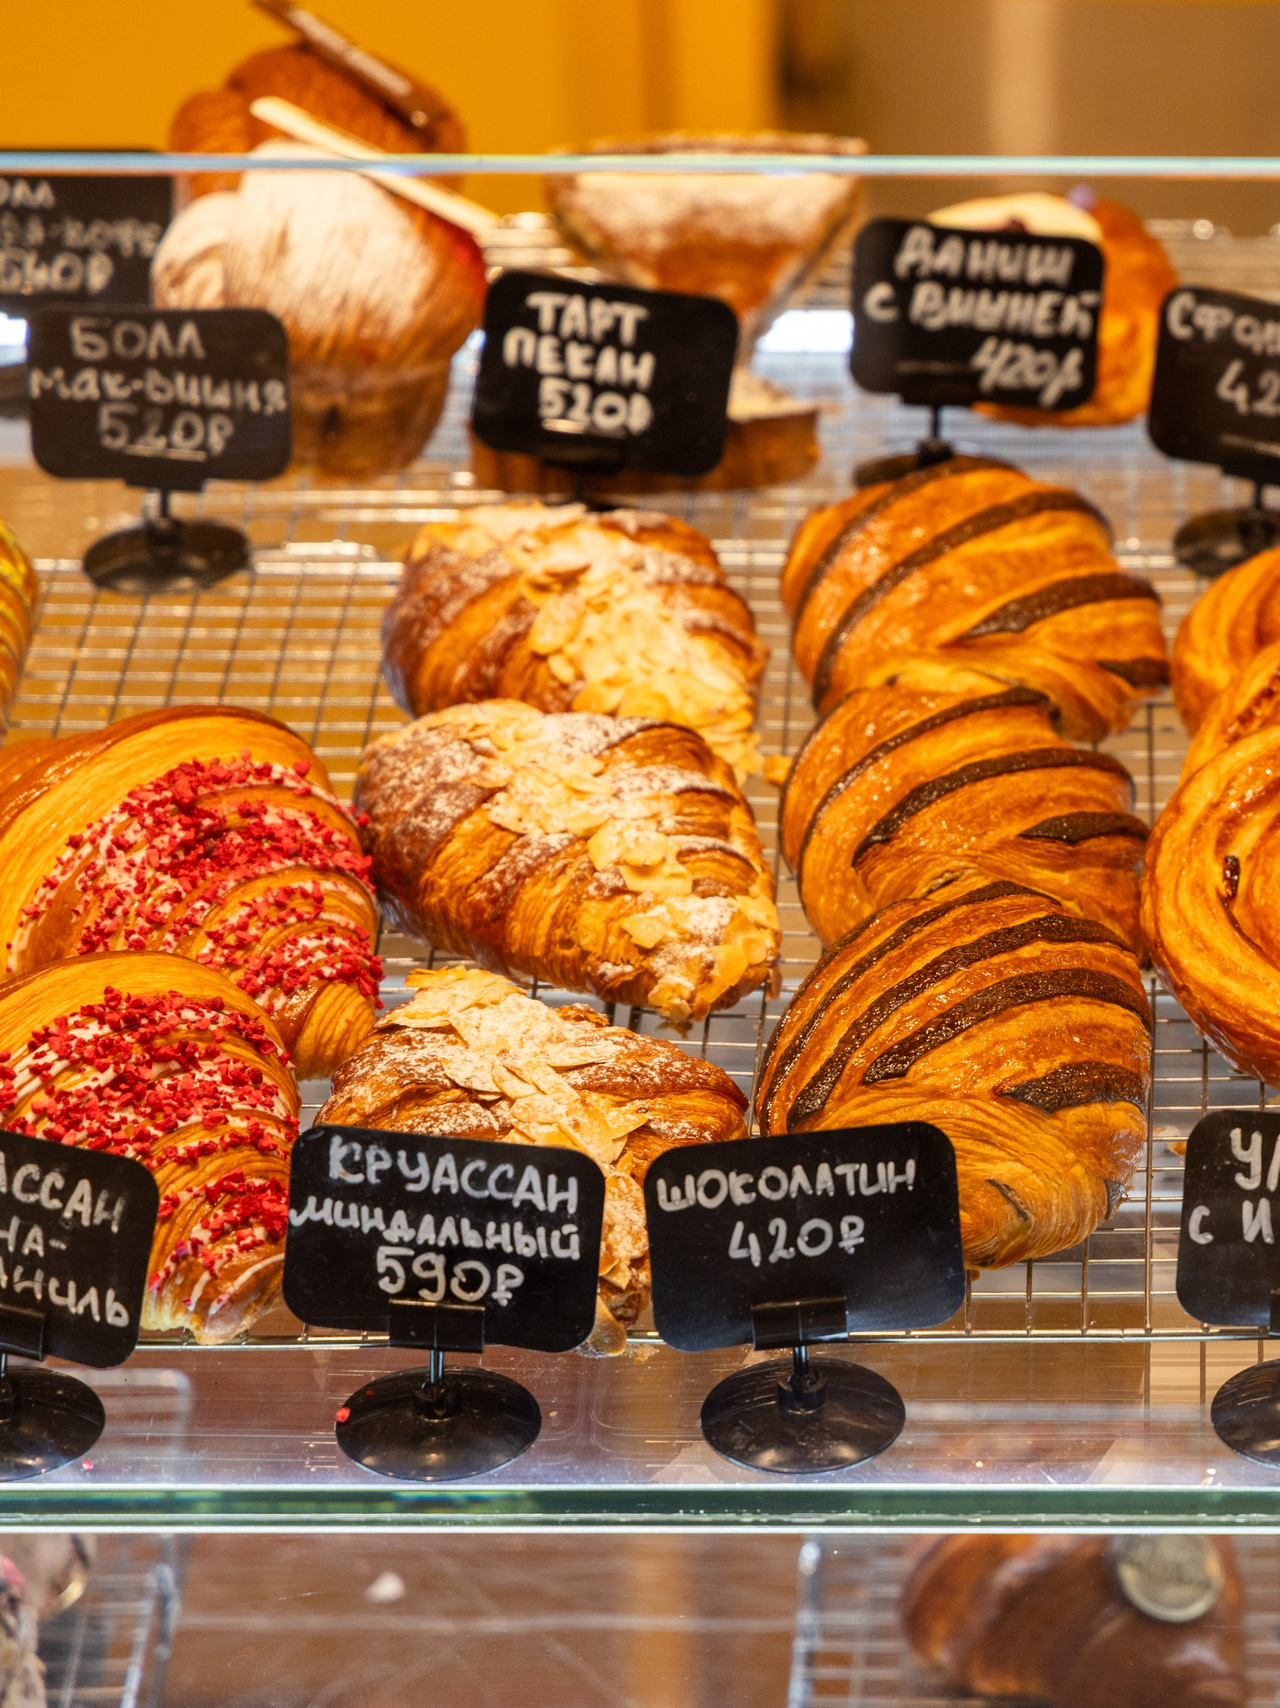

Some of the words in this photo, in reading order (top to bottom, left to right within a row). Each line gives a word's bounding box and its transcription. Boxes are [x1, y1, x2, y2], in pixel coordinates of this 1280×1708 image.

[525, 291, 649, 347] ТАРТ
[503, 326, 656, 391] ПЕКАН
[0, 1150, 125, 1234] ССАН
[328, 1135, 579, 1214] КРУАССАН
[656, 1158, 916, 1212] ШОКОЛАТИН
[0, 1257, 130, 1328] НИЛЬ
